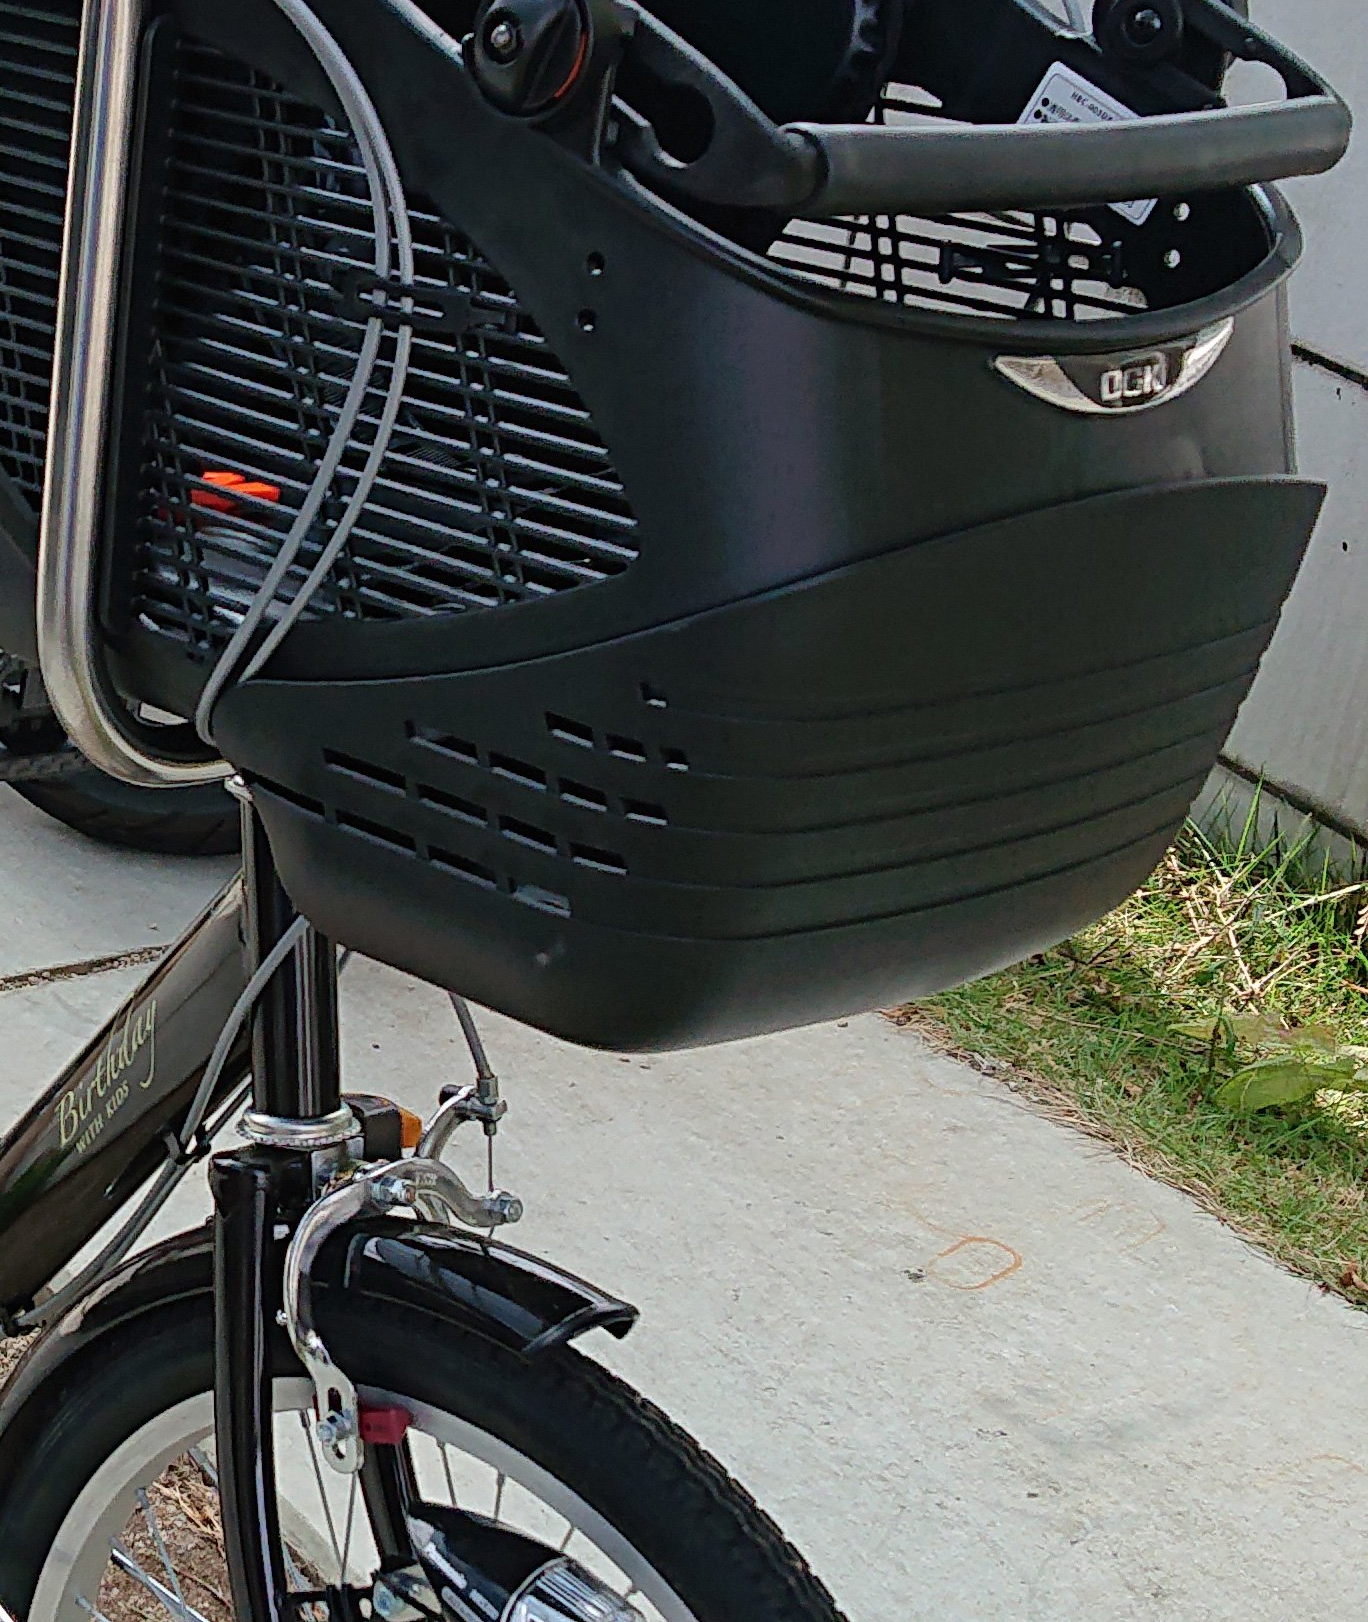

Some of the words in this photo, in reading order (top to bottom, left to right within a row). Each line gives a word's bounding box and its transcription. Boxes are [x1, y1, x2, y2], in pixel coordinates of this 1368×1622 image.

[55, 993, 157, 1148] Birthday
[75, 1113, 105, 1154] WITH
[105, 1079, 130, 1119] KIDS
